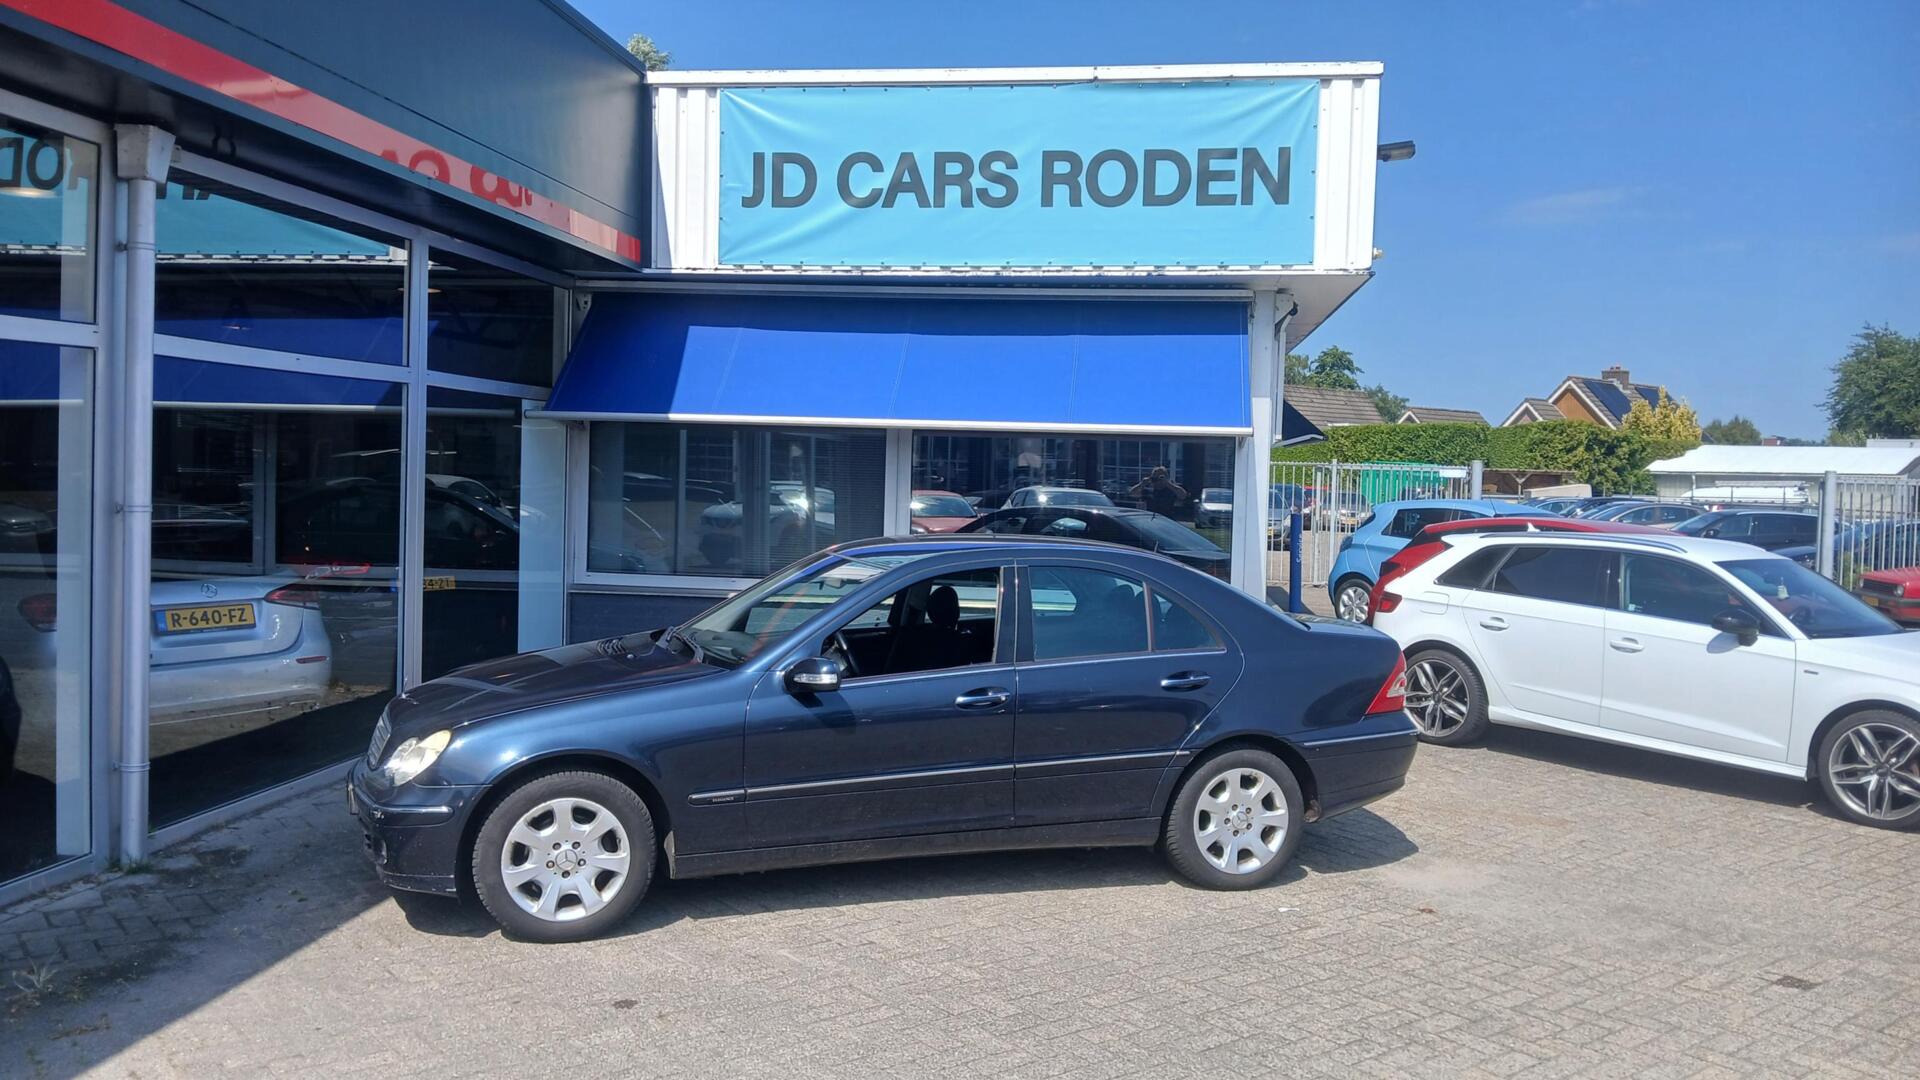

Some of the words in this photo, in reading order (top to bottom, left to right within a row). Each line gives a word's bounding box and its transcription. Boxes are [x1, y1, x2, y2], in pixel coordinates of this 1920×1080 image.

[741, 152, 818, 208] JD
[836, 150, 1019, 208] CARS
[1041, 147, 1291, 207] RODEN
[171, 608, 248, 628] R-640-FZ
